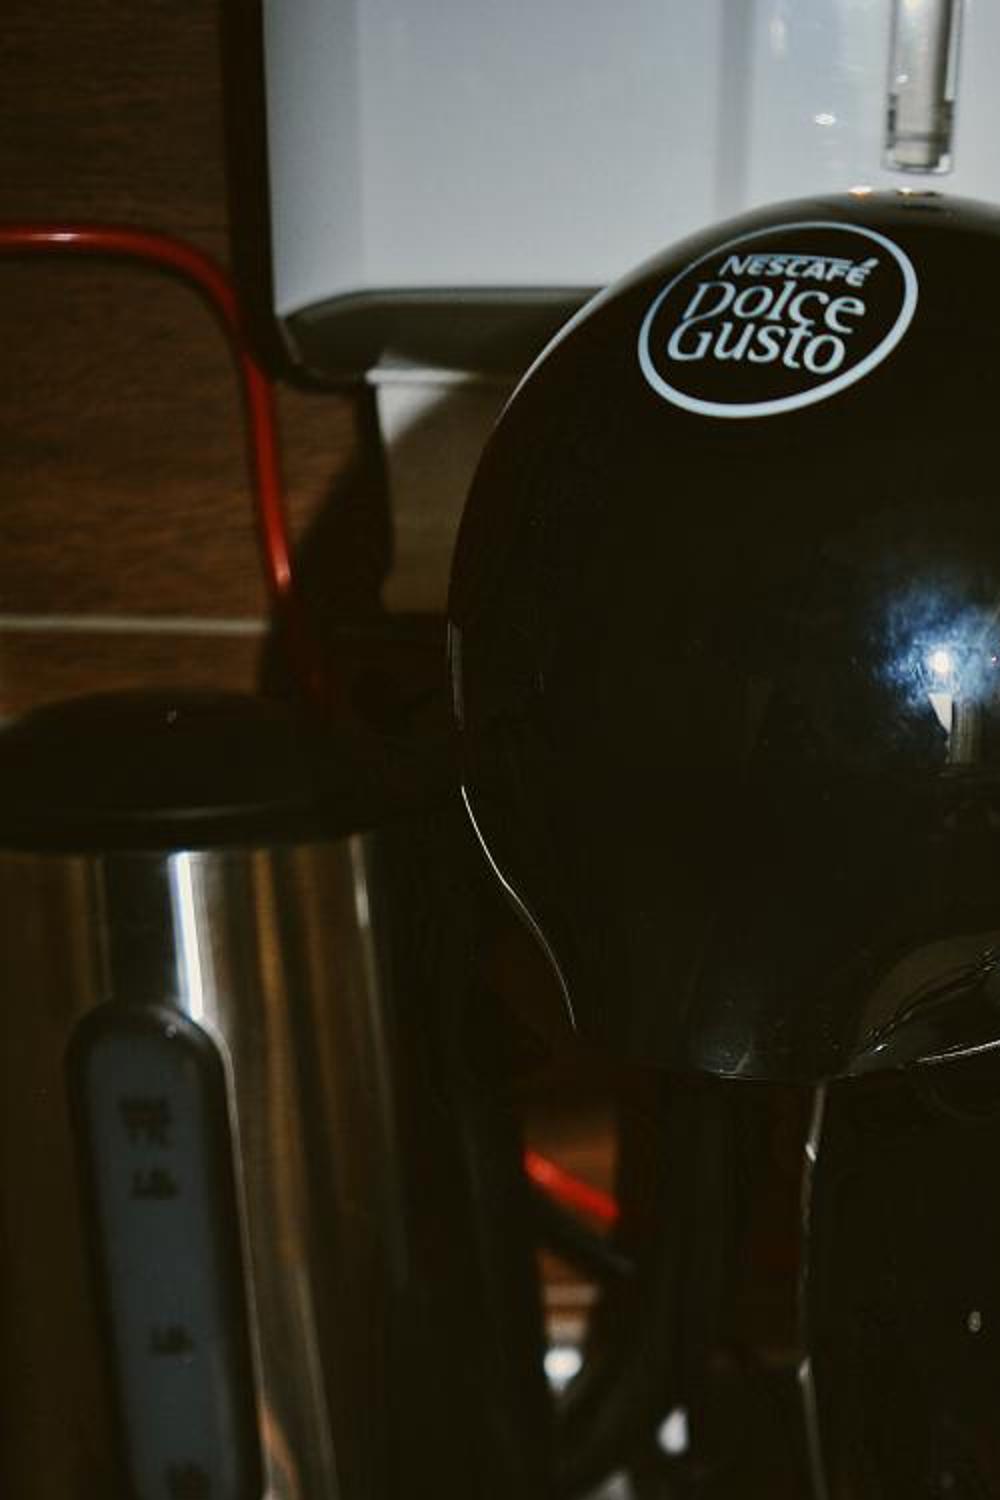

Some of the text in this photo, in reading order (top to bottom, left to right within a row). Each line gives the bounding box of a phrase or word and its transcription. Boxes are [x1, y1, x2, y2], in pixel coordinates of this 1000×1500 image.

[719, 254, 879, 286] NESCAFÉ
[683, 280, 866, 333] Dolce
[667, 321, 846, 374] Gusto
